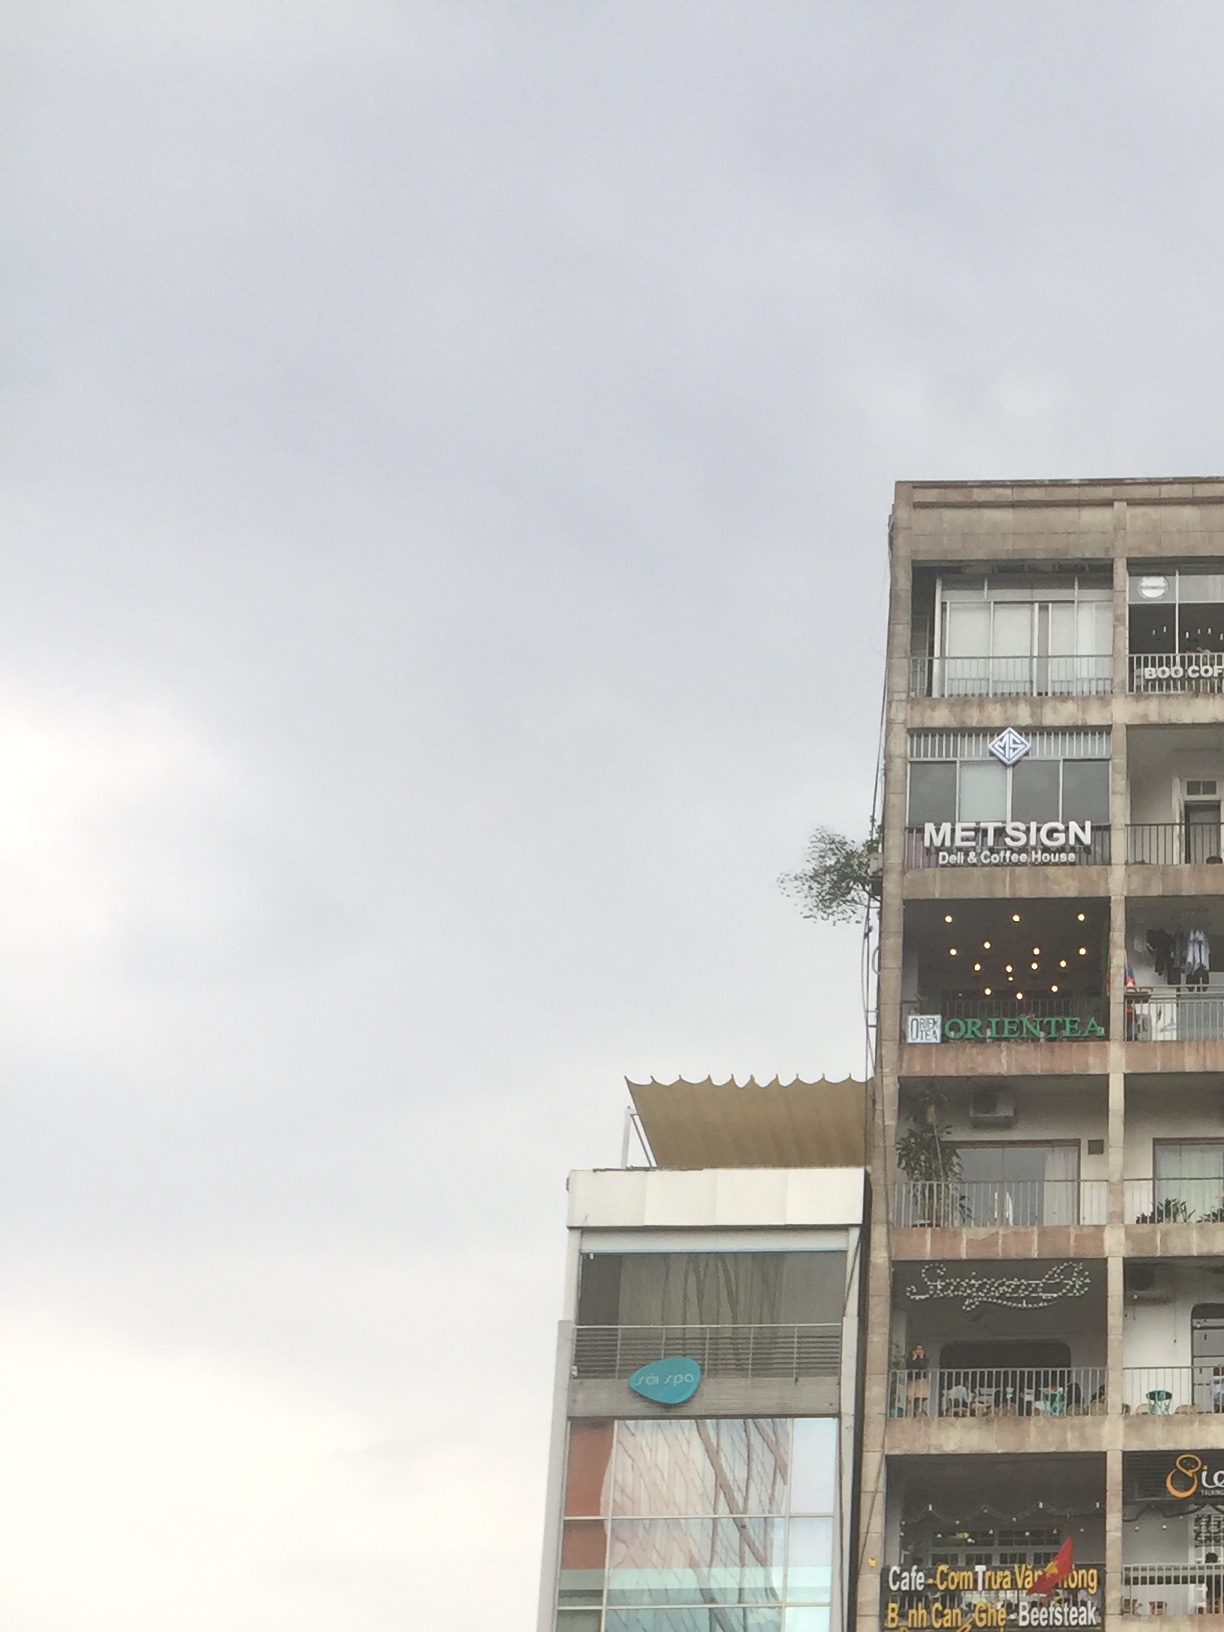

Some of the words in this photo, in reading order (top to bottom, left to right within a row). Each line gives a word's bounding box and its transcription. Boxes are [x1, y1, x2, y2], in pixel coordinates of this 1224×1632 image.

[1144, 666, 1184, 679] BOO
[924, 821, 1092, 848] METSIGN
[938, 851, 964, 864] Deli
[967, 851, 976, 863] &
[980, 850, 1027, 863] Coffee
[1031, 849, 1076, 863] House
[945, 1016, 1105, 1040] ORIENTEA
[888, 1565, 925, 1592] Cafe
[1018, 1600, 1098, 1627] Beefsteak
